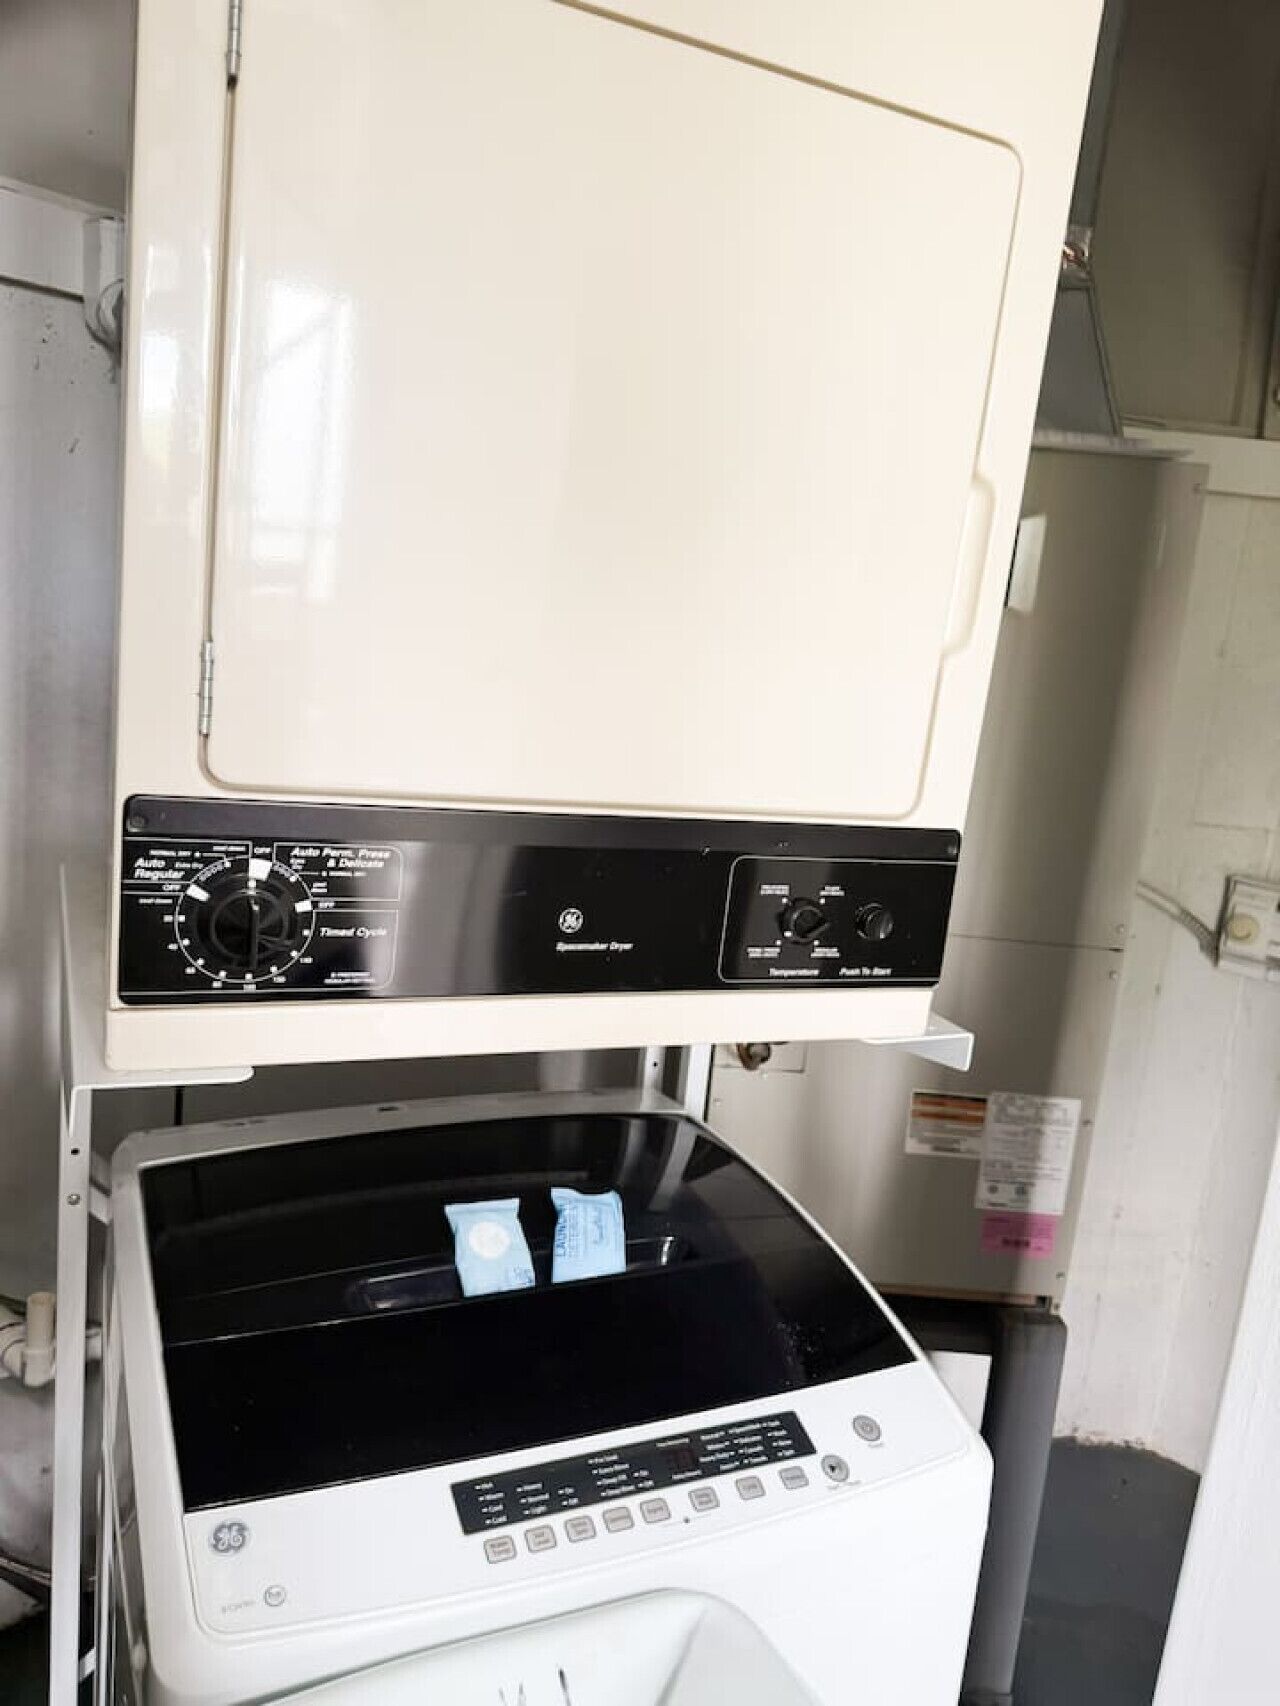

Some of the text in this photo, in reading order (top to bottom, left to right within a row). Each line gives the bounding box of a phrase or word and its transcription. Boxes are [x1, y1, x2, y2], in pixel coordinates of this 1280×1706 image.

[290, 846, 321, 858] Auto
[358, 848, 391, 859] Press
[134, 857, 166, 868] Auto
[338, 858, 385, 868] Delicate
[134, 868, 186, 881] Regular
[320, 926, 388, 939] Timed Cycle
[609, 941, 634, 953] Dryer
[839, 966, 860, 977] Push
